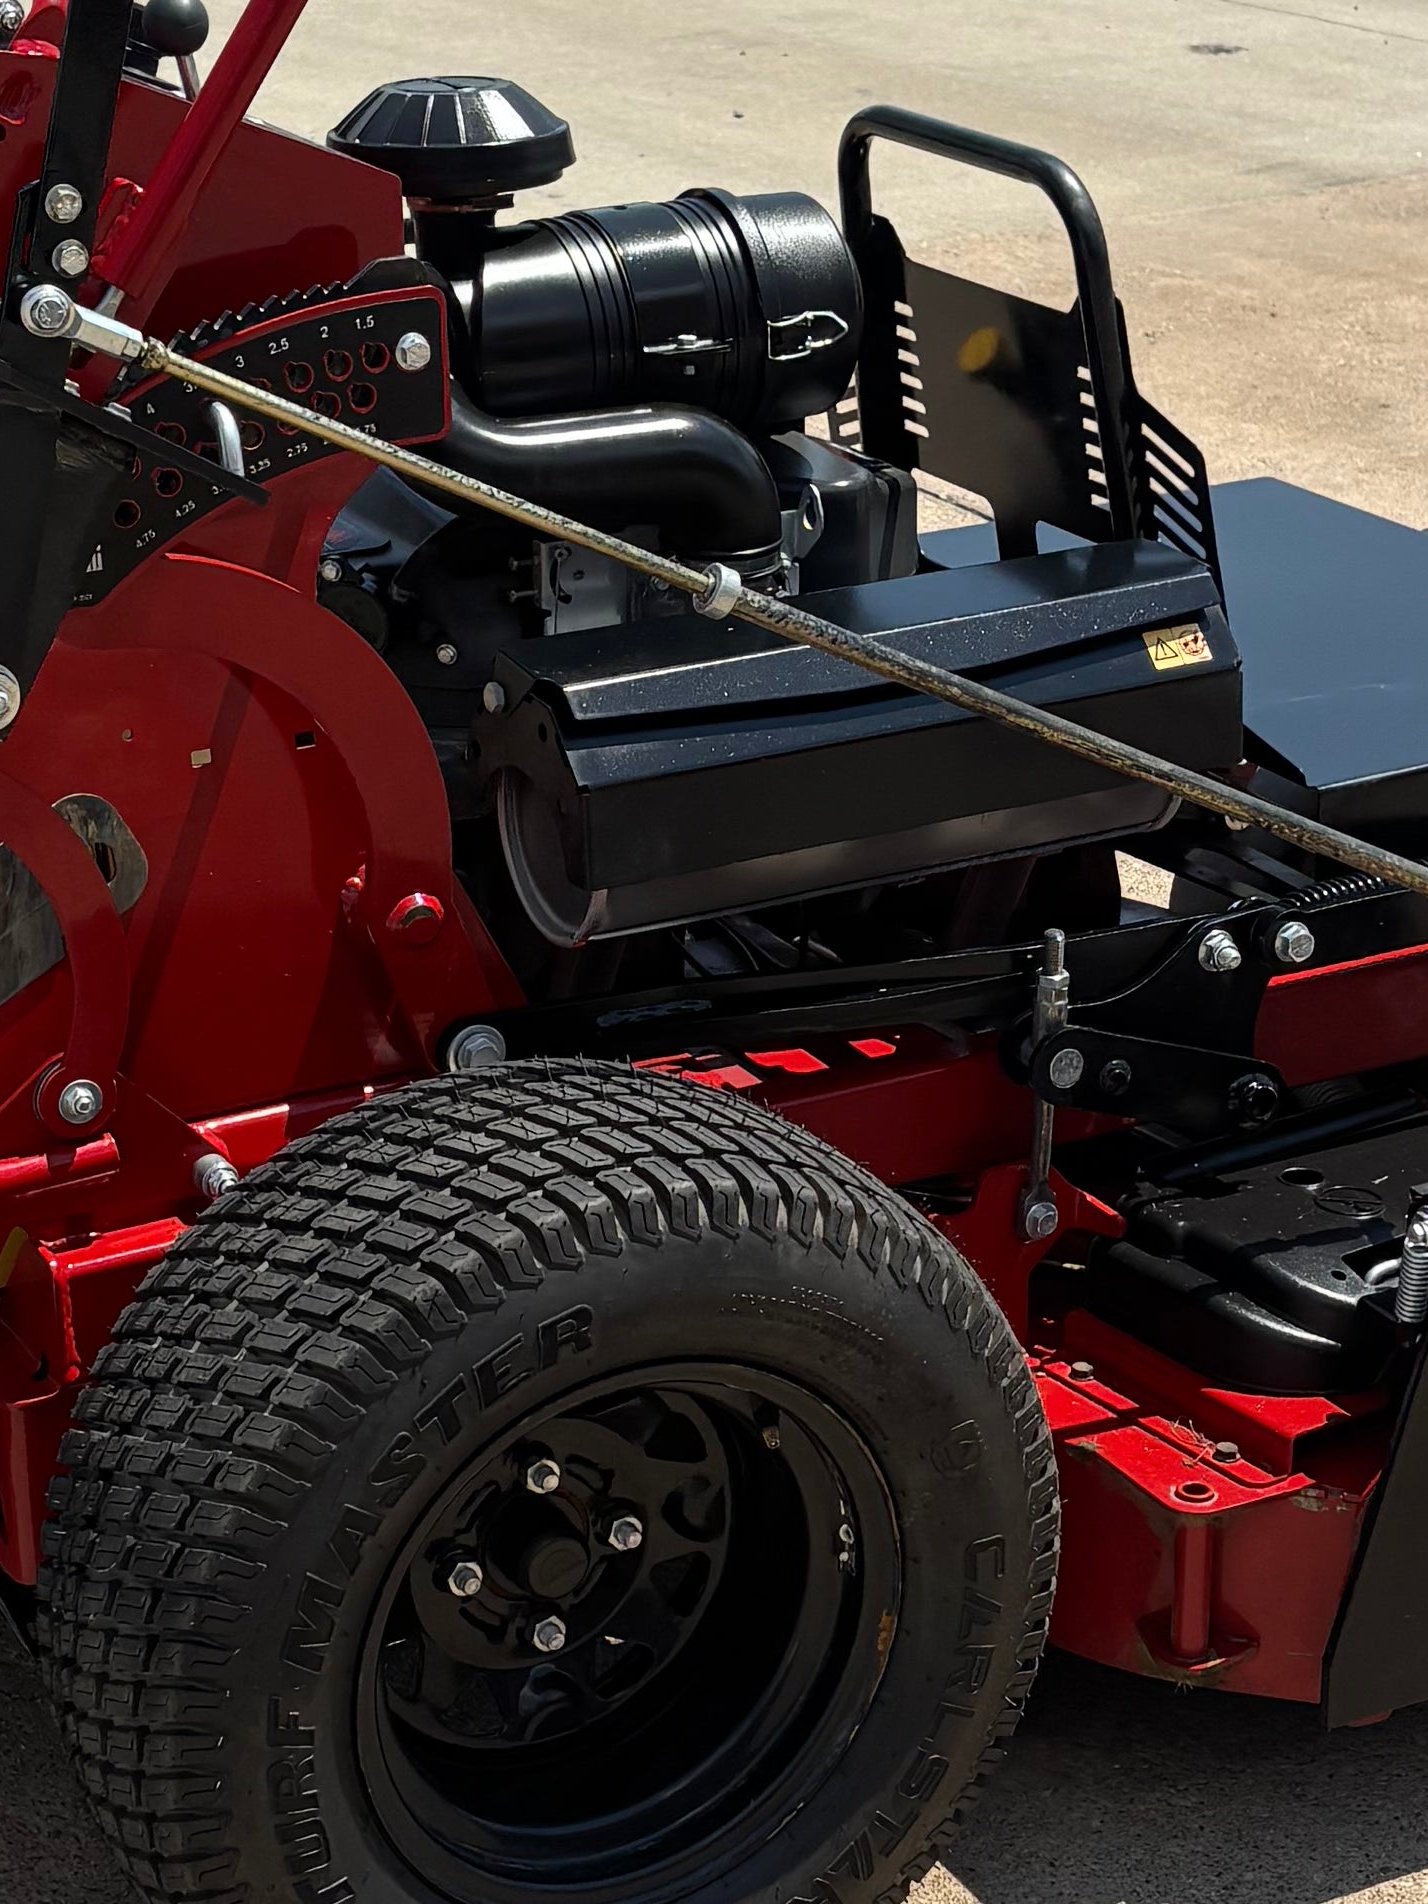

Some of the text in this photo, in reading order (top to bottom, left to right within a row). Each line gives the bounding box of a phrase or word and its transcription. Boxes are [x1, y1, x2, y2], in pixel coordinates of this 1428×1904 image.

[147, 402, 155, 414] 4
[236, 355, 245, 368] 3
[269, 337, 290, 355] 2.5
[321, 327, 329, 338] 2
[355, 314, 375, 330] 1.5
[135, 528, 156, 549] 4.75
[175, 499, 196, 518] 4.25
[249, 458, 271, 474] 3.25
[286, 442, 308, 458] 2.75
[283, 1303, 596, 1674] MASTER
